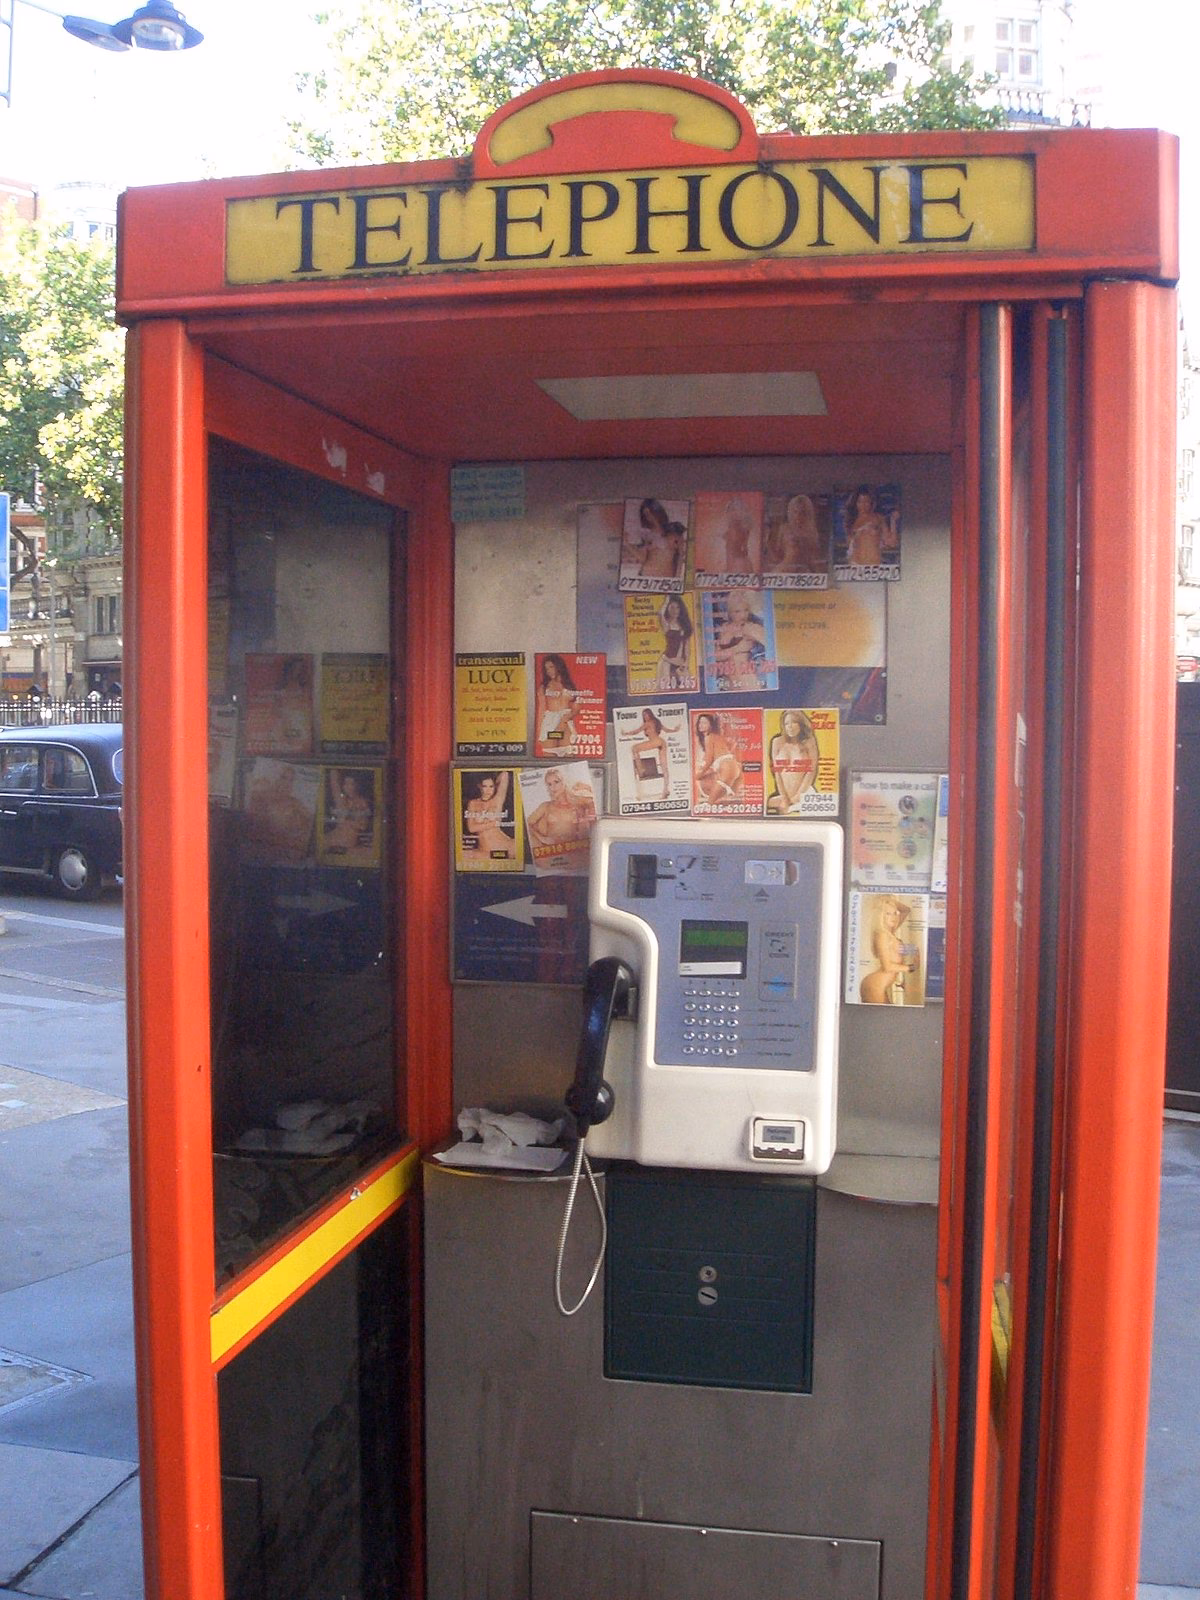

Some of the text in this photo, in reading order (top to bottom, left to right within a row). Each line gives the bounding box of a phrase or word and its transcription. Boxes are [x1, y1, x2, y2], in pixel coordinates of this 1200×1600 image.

[275, 162, 974, 275] TELEPHONE
[458, 654, 524, 666] transsexual
[576, 655, 599, 665] NEW
[468, 669, 515, 685] LUCY
[804, 794, 833, 803] 07944
[623, 803, 652, 813] 07944
[801, 803, 836, 812] 560650
